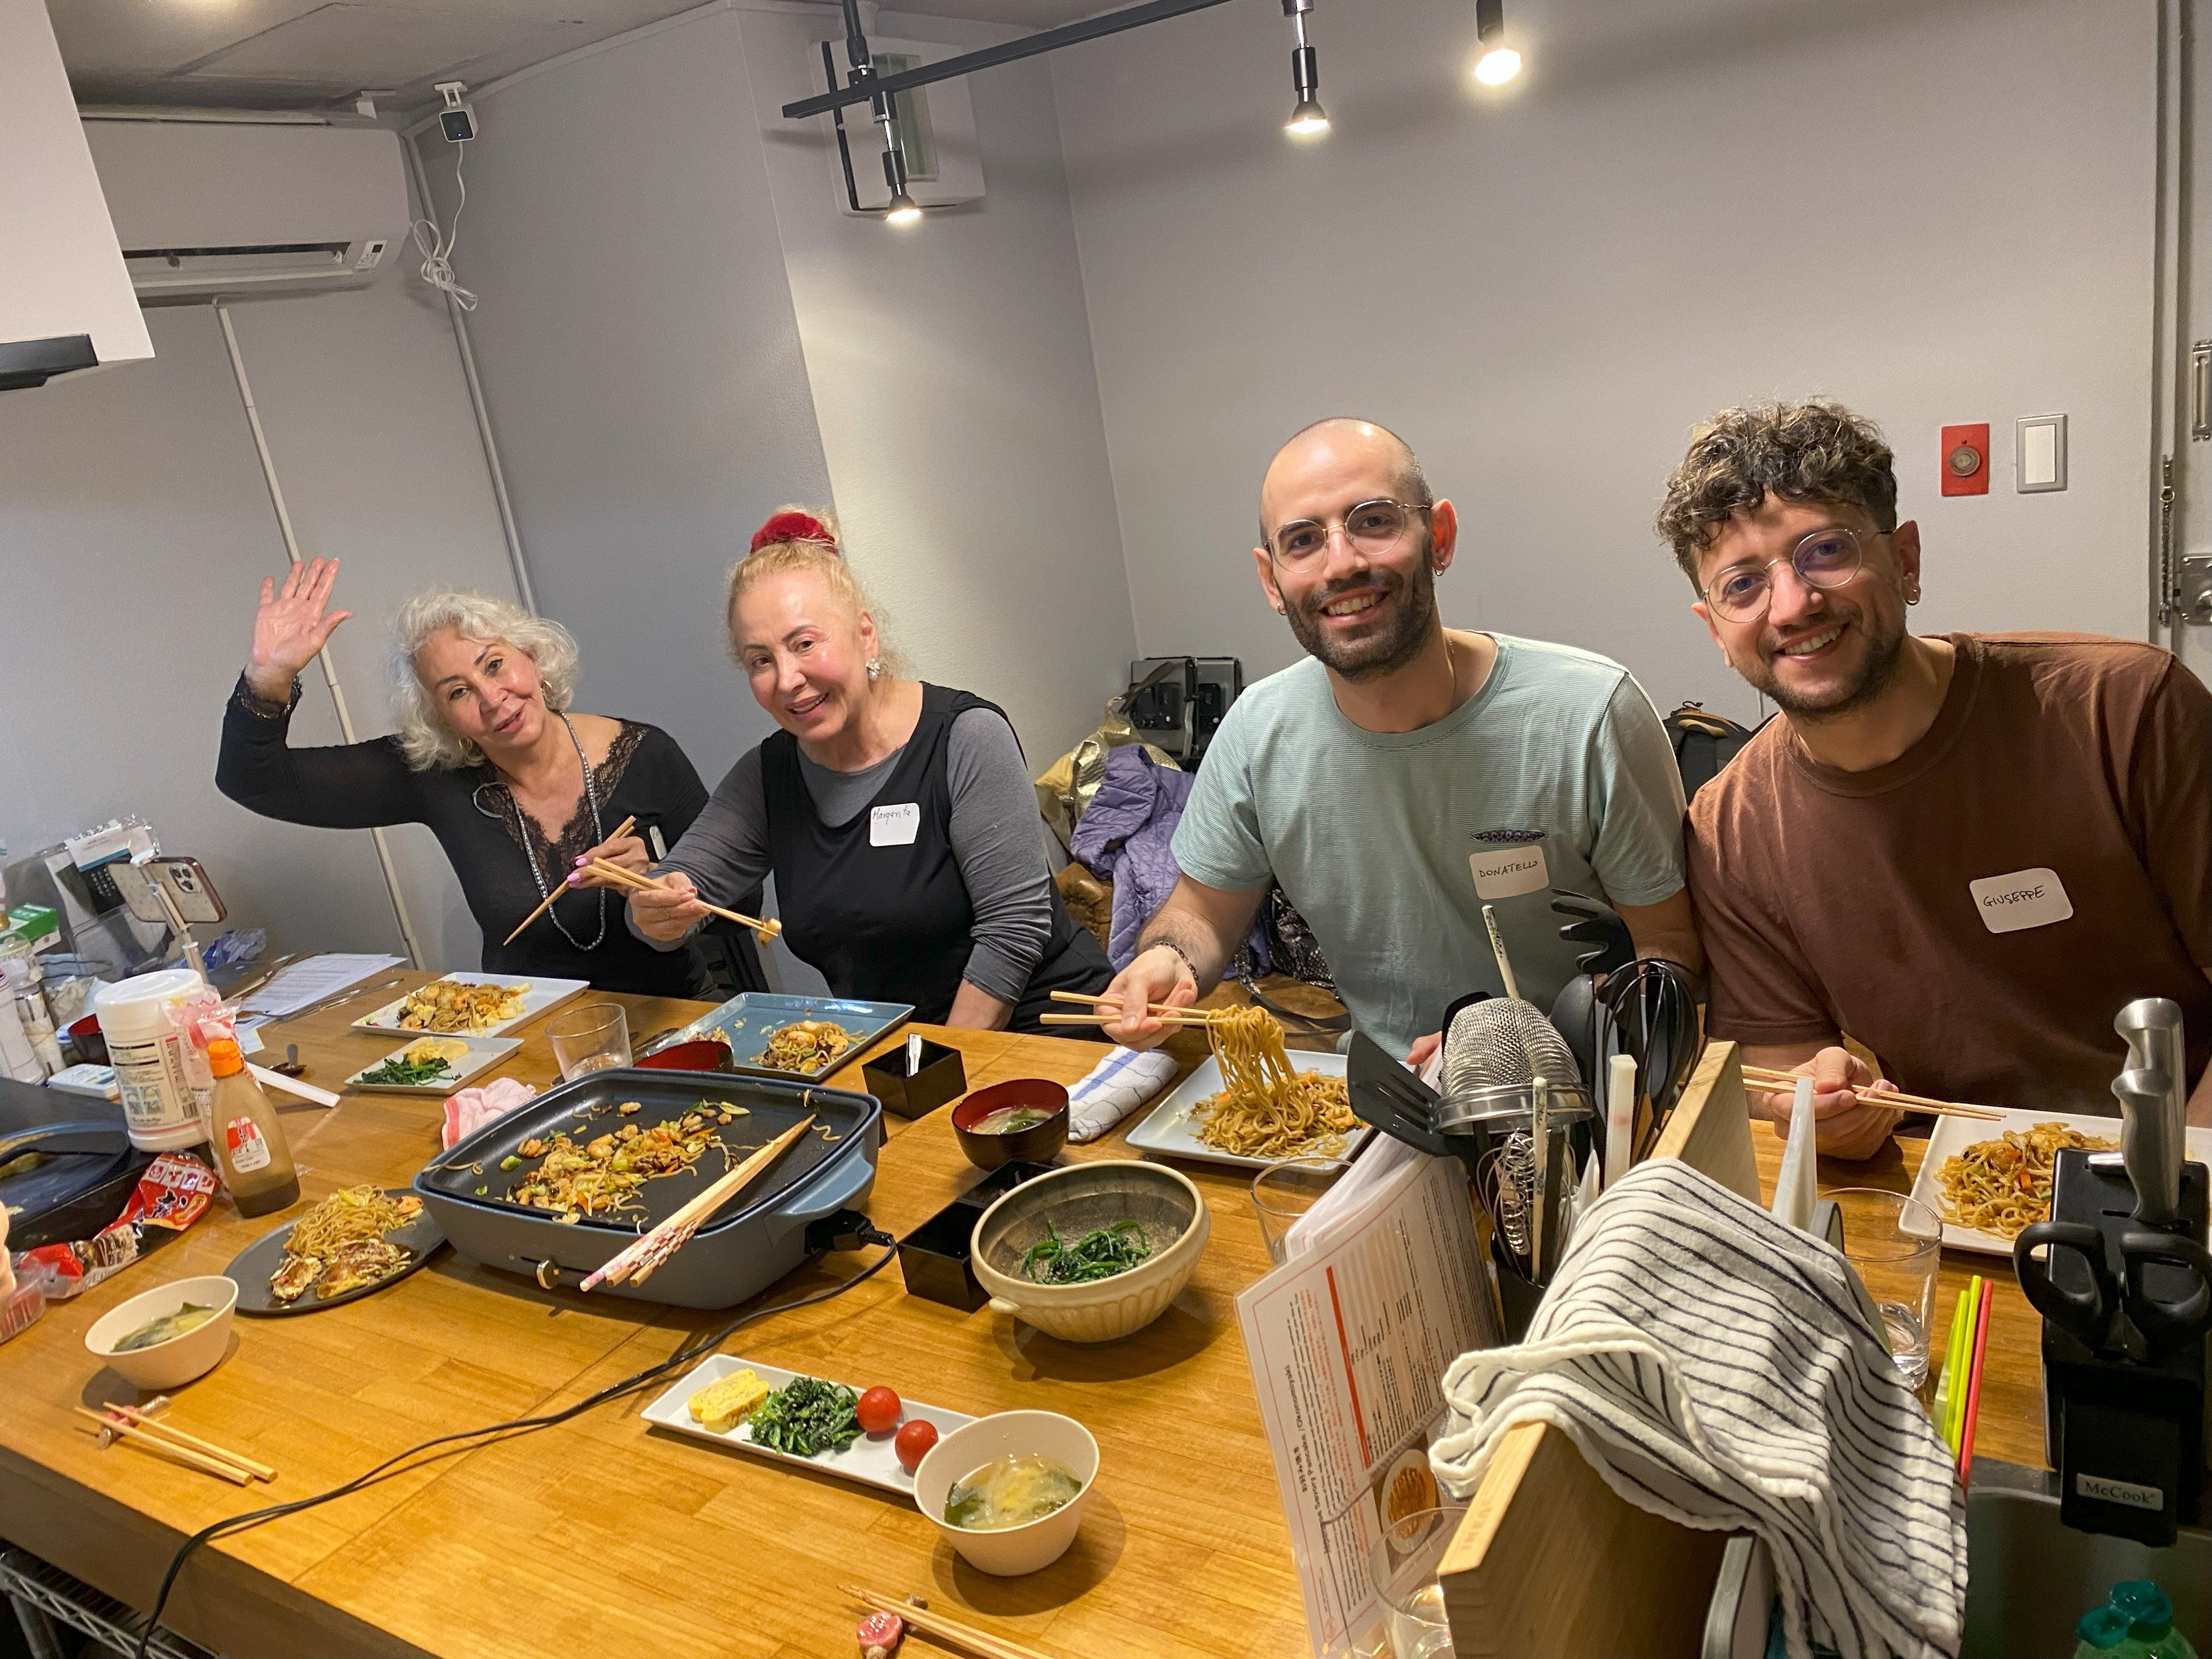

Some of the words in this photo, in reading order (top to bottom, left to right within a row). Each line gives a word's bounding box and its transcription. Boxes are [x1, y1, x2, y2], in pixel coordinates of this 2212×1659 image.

[1479, 861, 1538, 878] DONATELLO
[1983, 885, 2045, 907] GIUSEPPE
[1301, 1433, 1313, 1477] Pancake
[1311, 1477, 1321, 1510] Savory
[2085, 1481, 2152, 1505] McCook
